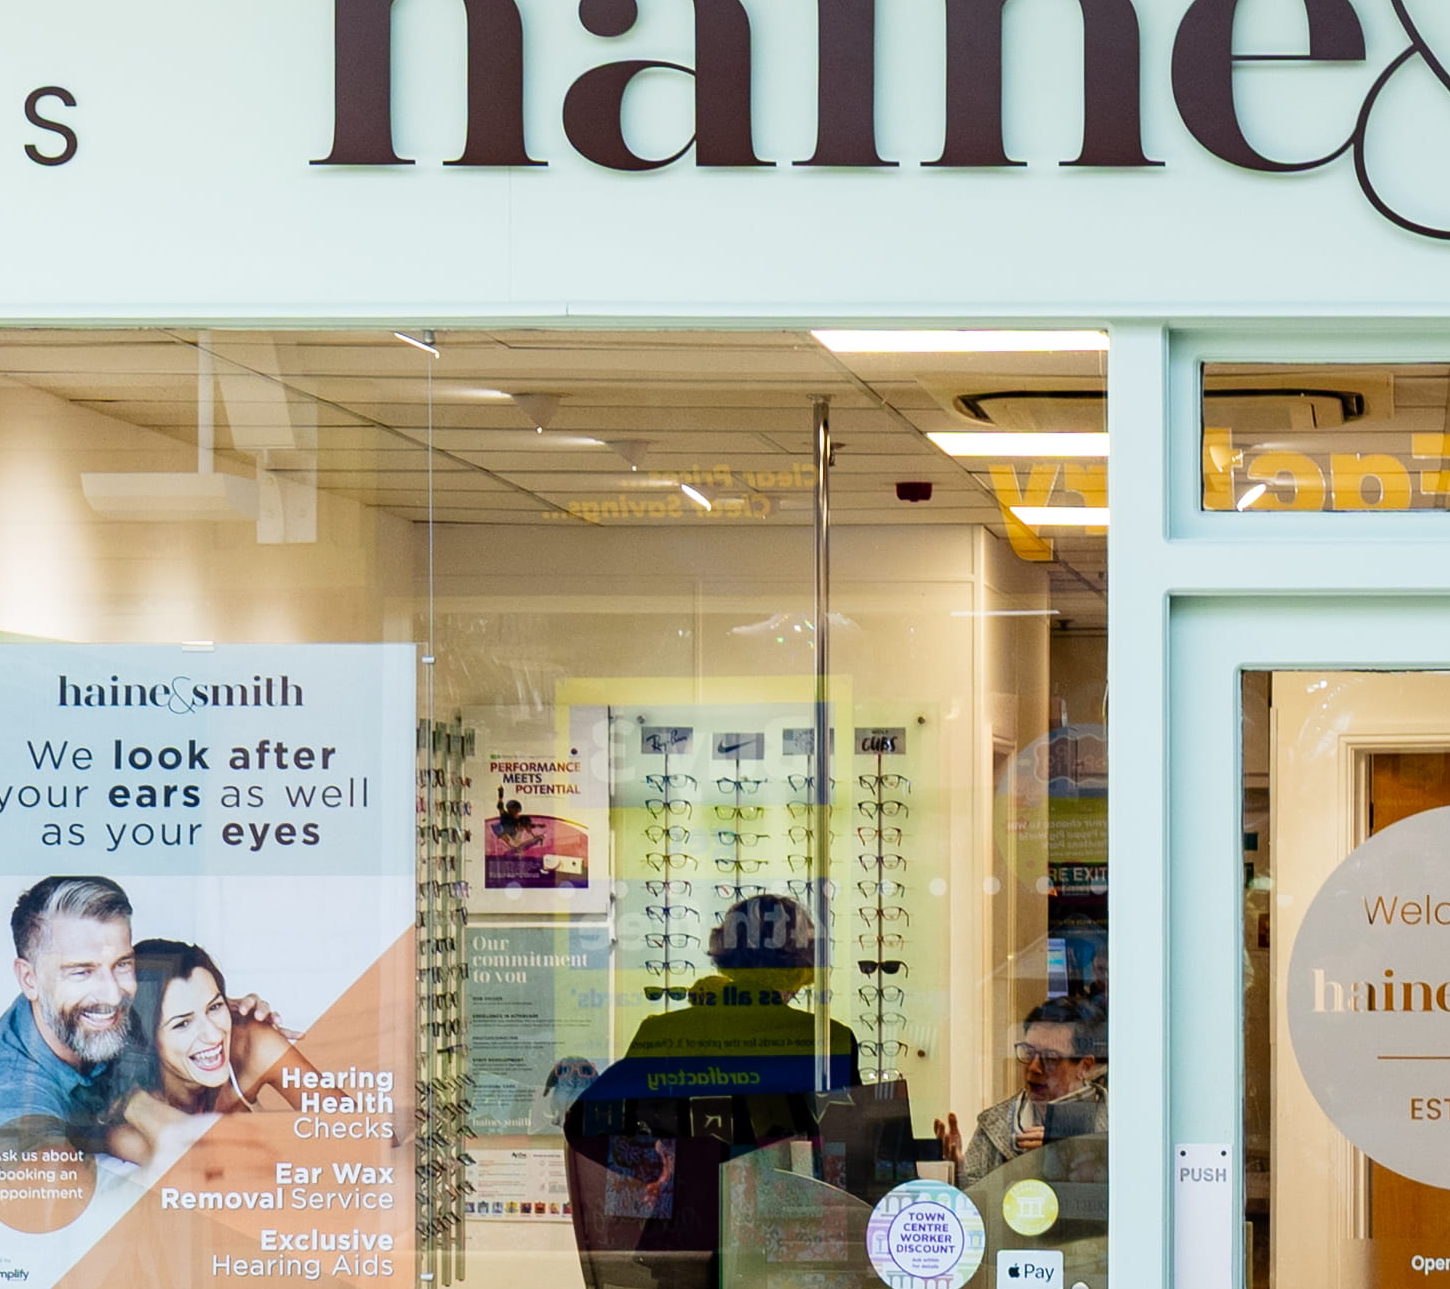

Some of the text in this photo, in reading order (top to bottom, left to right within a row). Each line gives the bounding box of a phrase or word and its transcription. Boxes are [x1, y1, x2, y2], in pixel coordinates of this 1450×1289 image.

[58, 675, 305, 714] haine&smith
[861, 736, 897, 753] CUBS
[27, 739, 337, 771] We look after
[490, 762, 581, 772] PERFORMANCE
[502, 773, 542, 784] MEETS
[108, 784, 202, 809] ears
[220, 784, 265, 809] as
[285, 777, 370, 809] well
[515, 784, 581, 795] POTENTIAL
[41, 822, 322, 852] as your eyes
[1073, 867, 1109, 882] EXIT
[472, 935, 510, 952] Our
[472, 952, 589, 968] commitment
[472, 968, 491, 984] to
[282, 1067, 395, 1095] Hearing
[301, 1091, 395, 1115] Health
[293, 1117, 395, 1140] Checks
[21, 1151, 38, 1162] us
[42, 1149, 85, 1162] about
[59, 1170, 78, 1181] an
[276, 1163, 395, 1186] Ear Wax
[1179, 1167, 1228, 1184] PUSH
[161, 1187, 395, 1211] Removal Service
[908, 1212, 946, 1222] TOWN
[903, 1222, 950, 1233] CENTRE
[261, 1229, 395, 1253] Exclusive
[900, 1233, 952, 1243] WORKER
[896, 1243, 956, 1254] DISCOUNT
[212, 1254, 395, 1281] Hearing Aids
[1024, 1262, 1056, 1283] Pay
